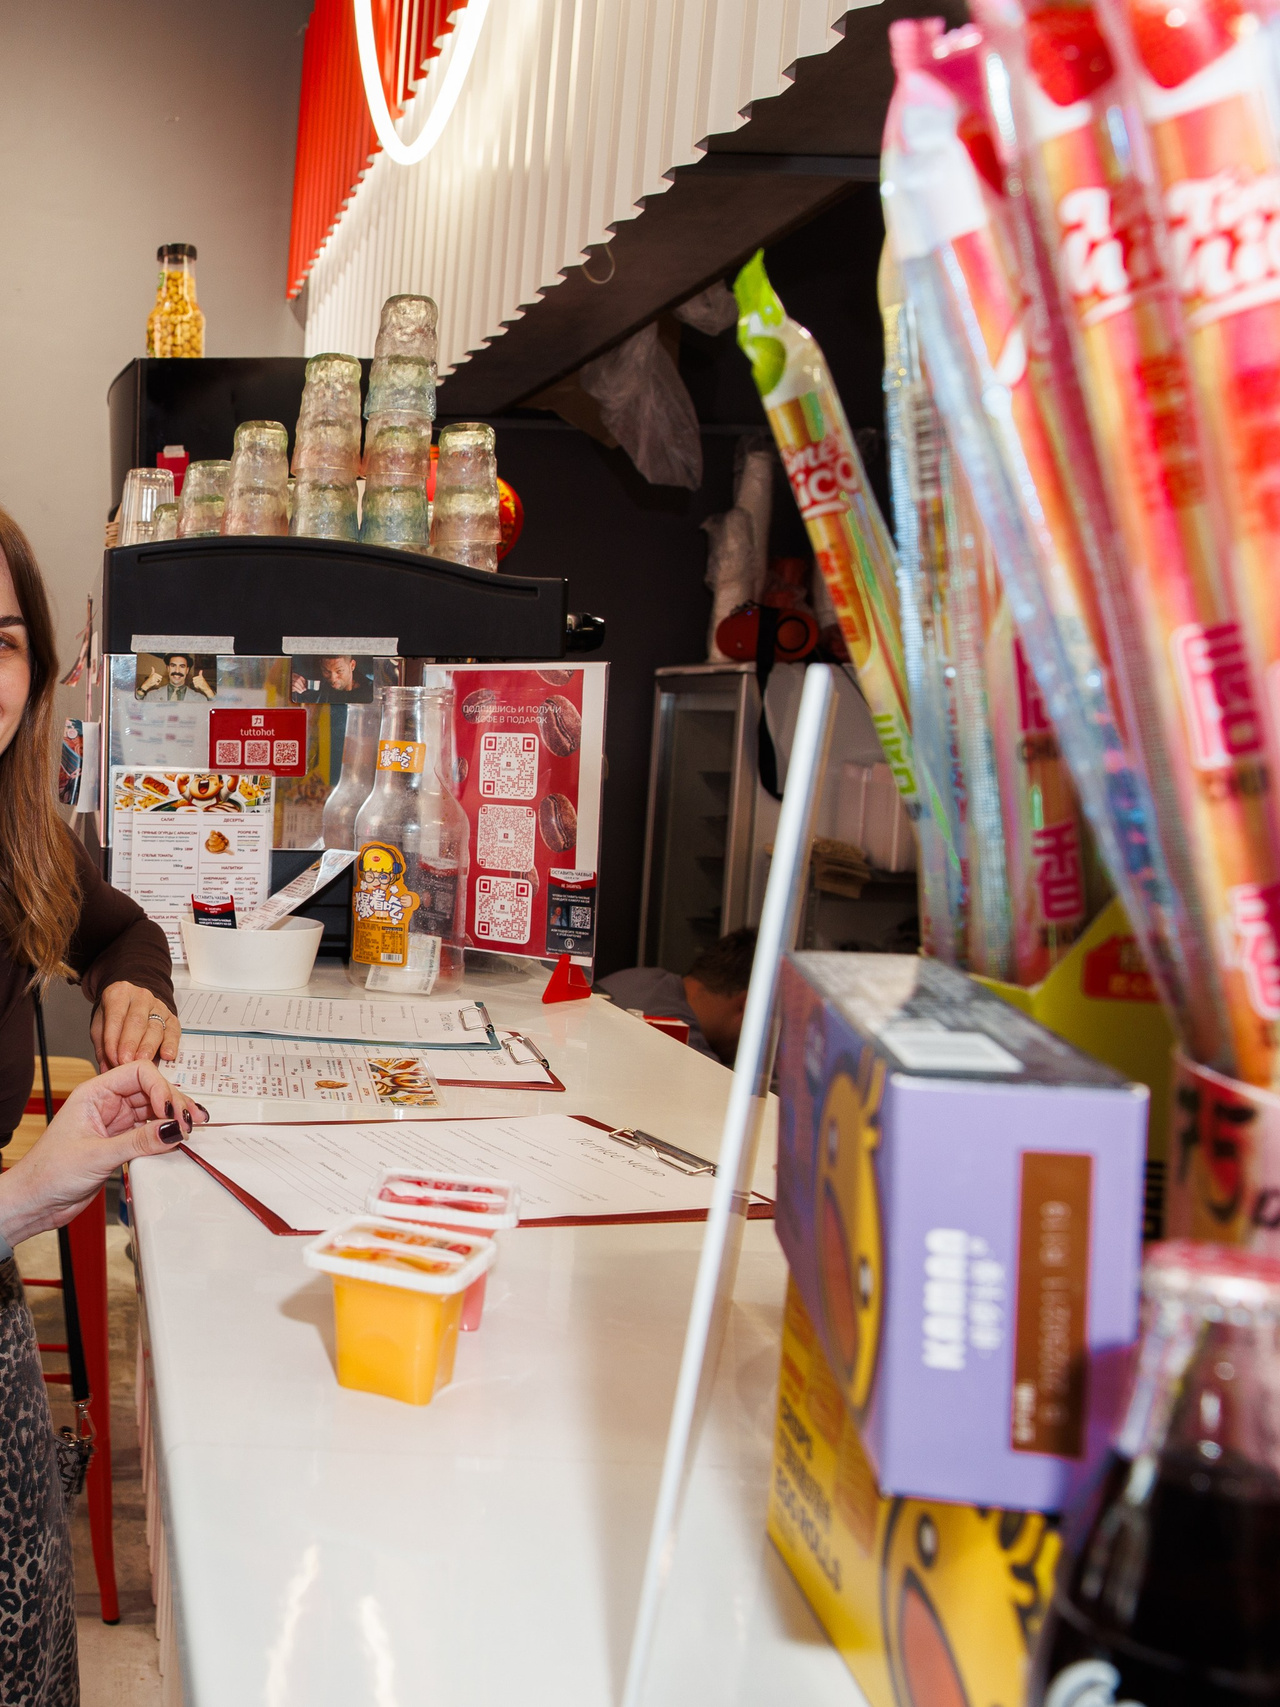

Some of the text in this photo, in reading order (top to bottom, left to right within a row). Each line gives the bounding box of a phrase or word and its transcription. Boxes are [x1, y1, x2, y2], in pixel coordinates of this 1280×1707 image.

[462, 705, 516, 713] ПОДПИШИСЬ
[475, 716, 498, 724] КОФЕ
[506, 716, 548, 724] ПОДАРОК
[240, 728, 275, 736] tuttohot
